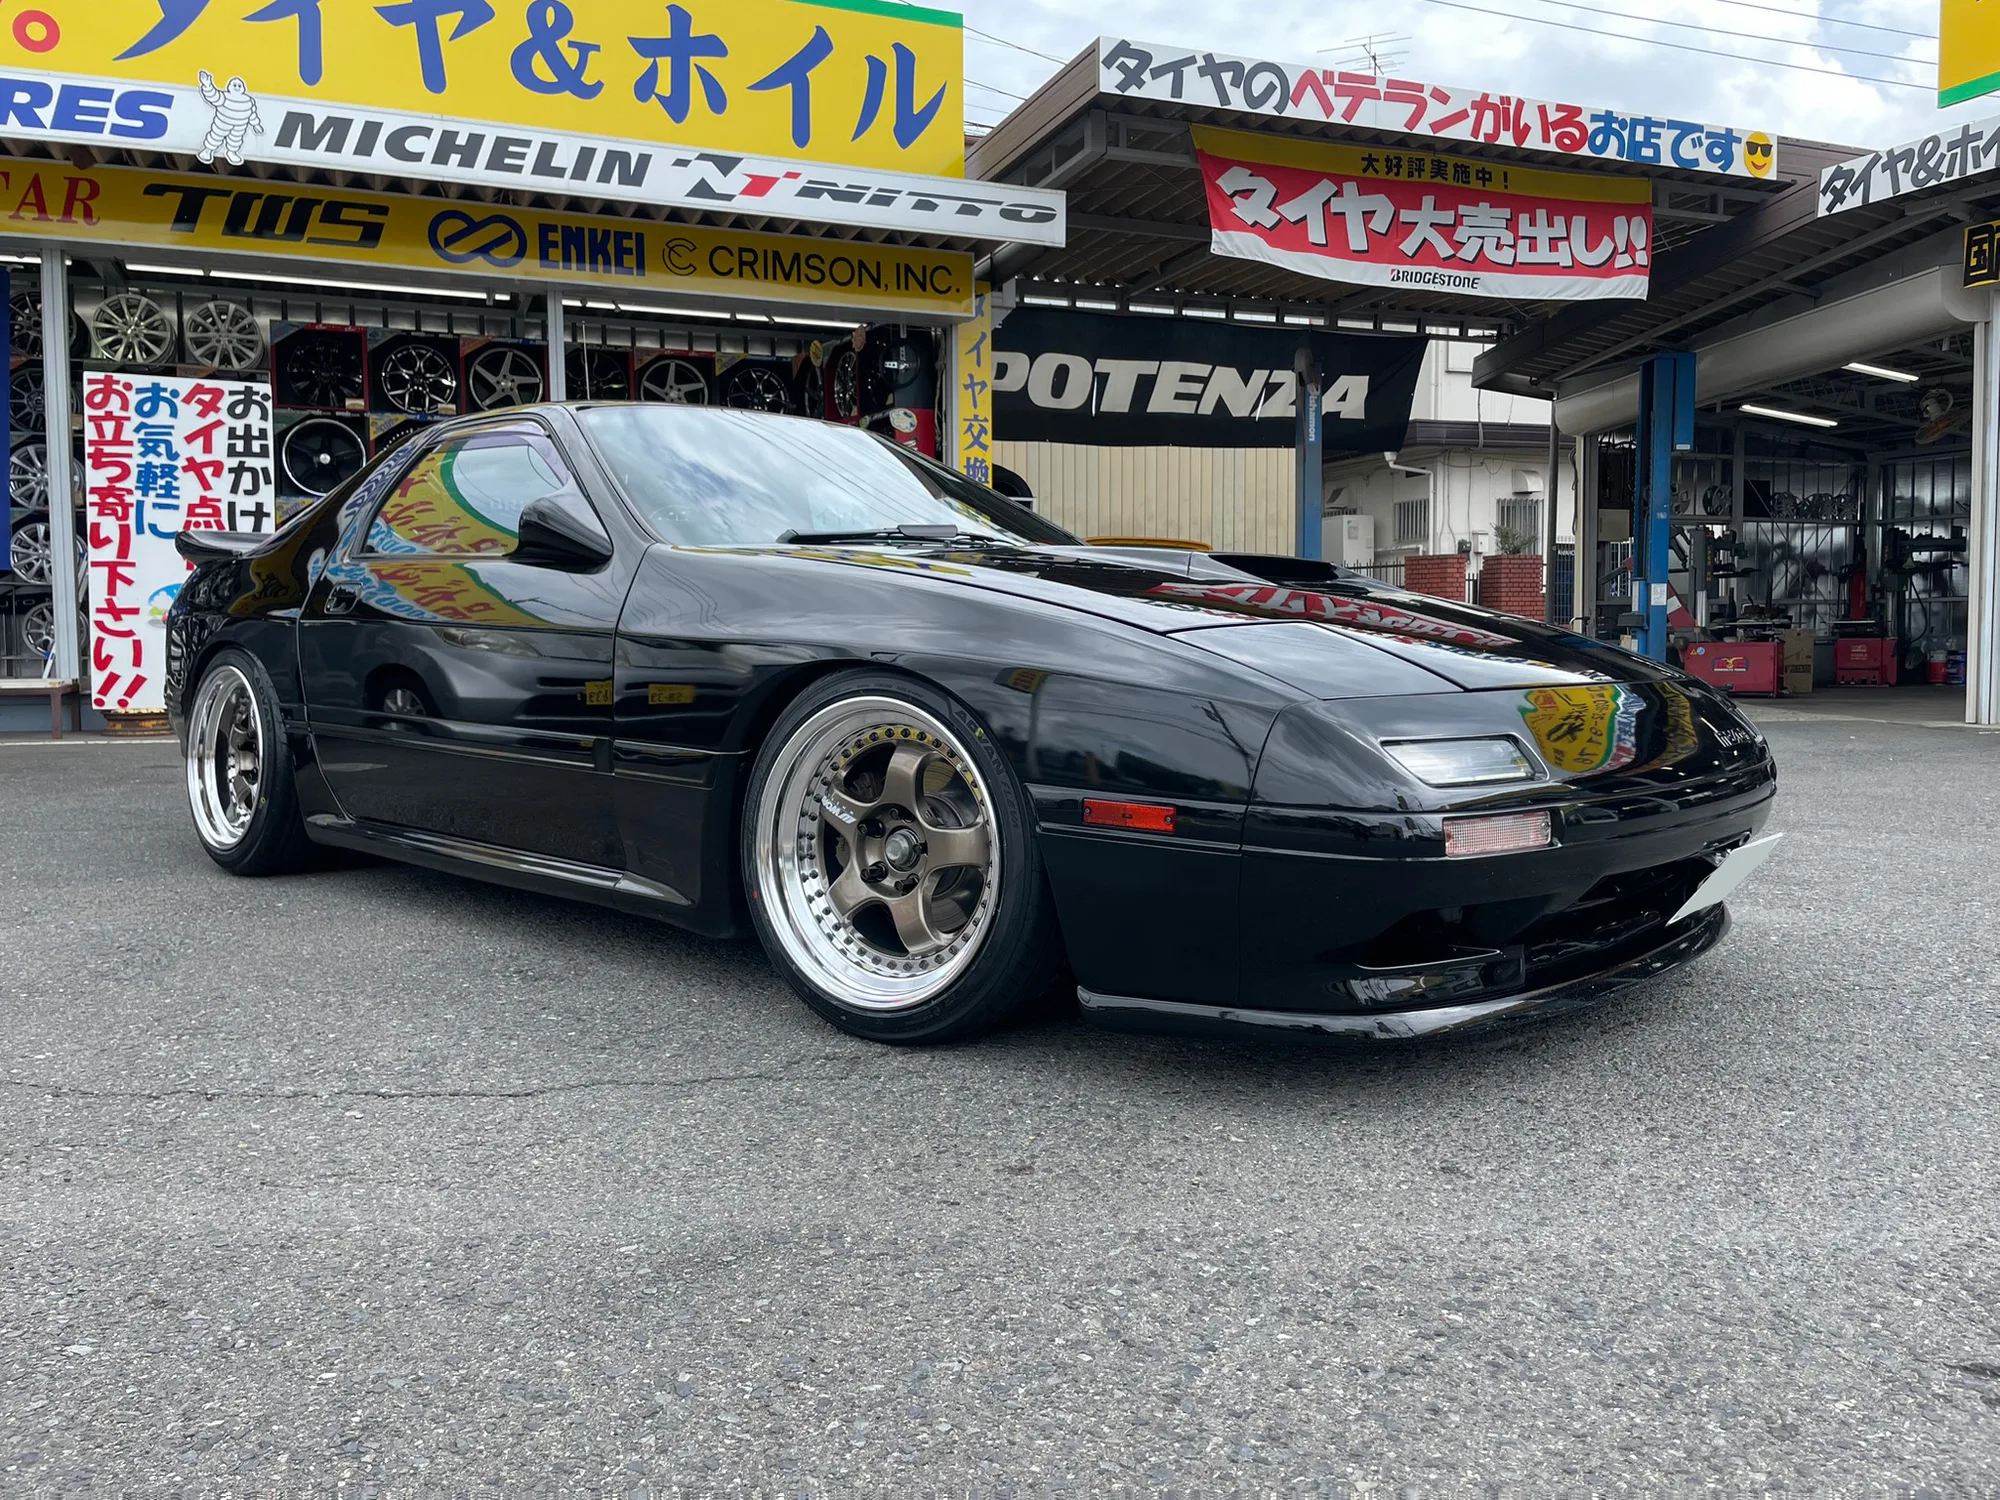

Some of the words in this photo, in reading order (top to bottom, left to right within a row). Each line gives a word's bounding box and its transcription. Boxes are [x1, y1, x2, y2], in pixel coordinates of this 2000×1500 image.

[273, 111, 653, 188] MICHELIN
[0, 171, 101, 226] AR
[143, 183, 390, 249] TWS
[794, 180, 1059, 225] NITTO
[538, 223, 646, 277] ENKEI
[1390, 268, 1480, 289] BRIDGESTONE
[133, 382, 181, 539] お気軽に
[181, 382, 226, 571] タイヤ点
[227, 385, 272, 532] お出かけ
